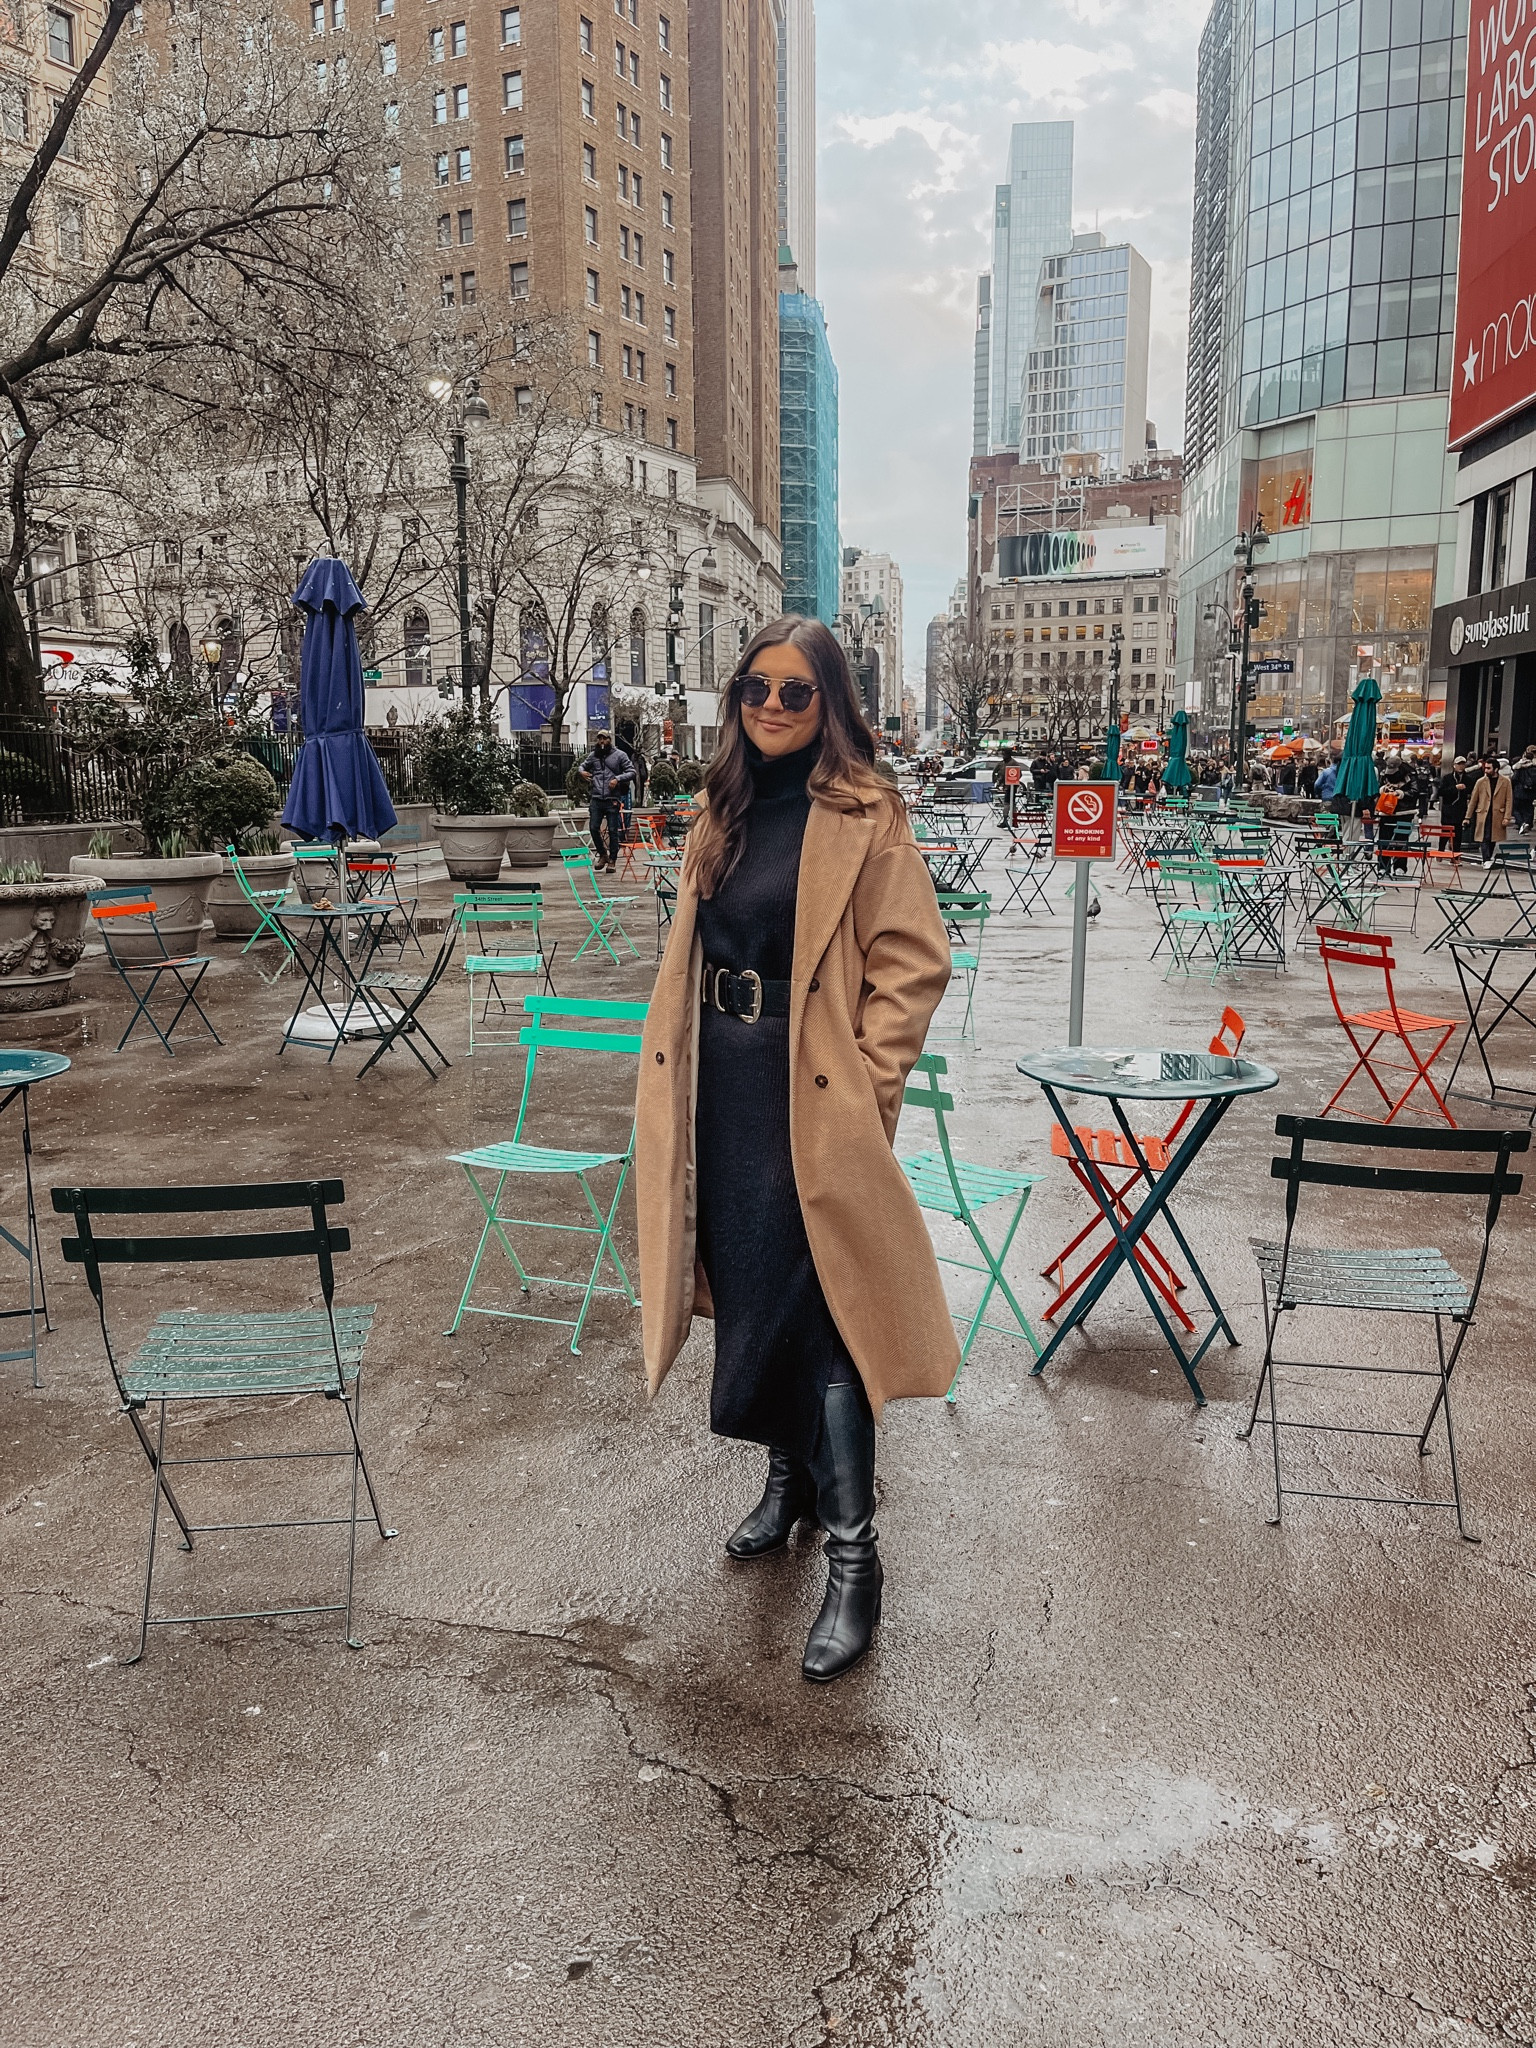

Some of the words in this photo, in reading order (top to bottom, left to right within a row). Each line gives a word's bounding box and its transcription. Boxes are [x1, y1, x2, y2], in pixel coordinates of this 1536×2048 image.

[1479, 0, 1536, 75] WO
[1487, 113, 1536, 212] STO
[1465, 611, 1509, 648] sunglass
[1509, 605, 1530, 634] hut
[53, 667, 79, 680] One
